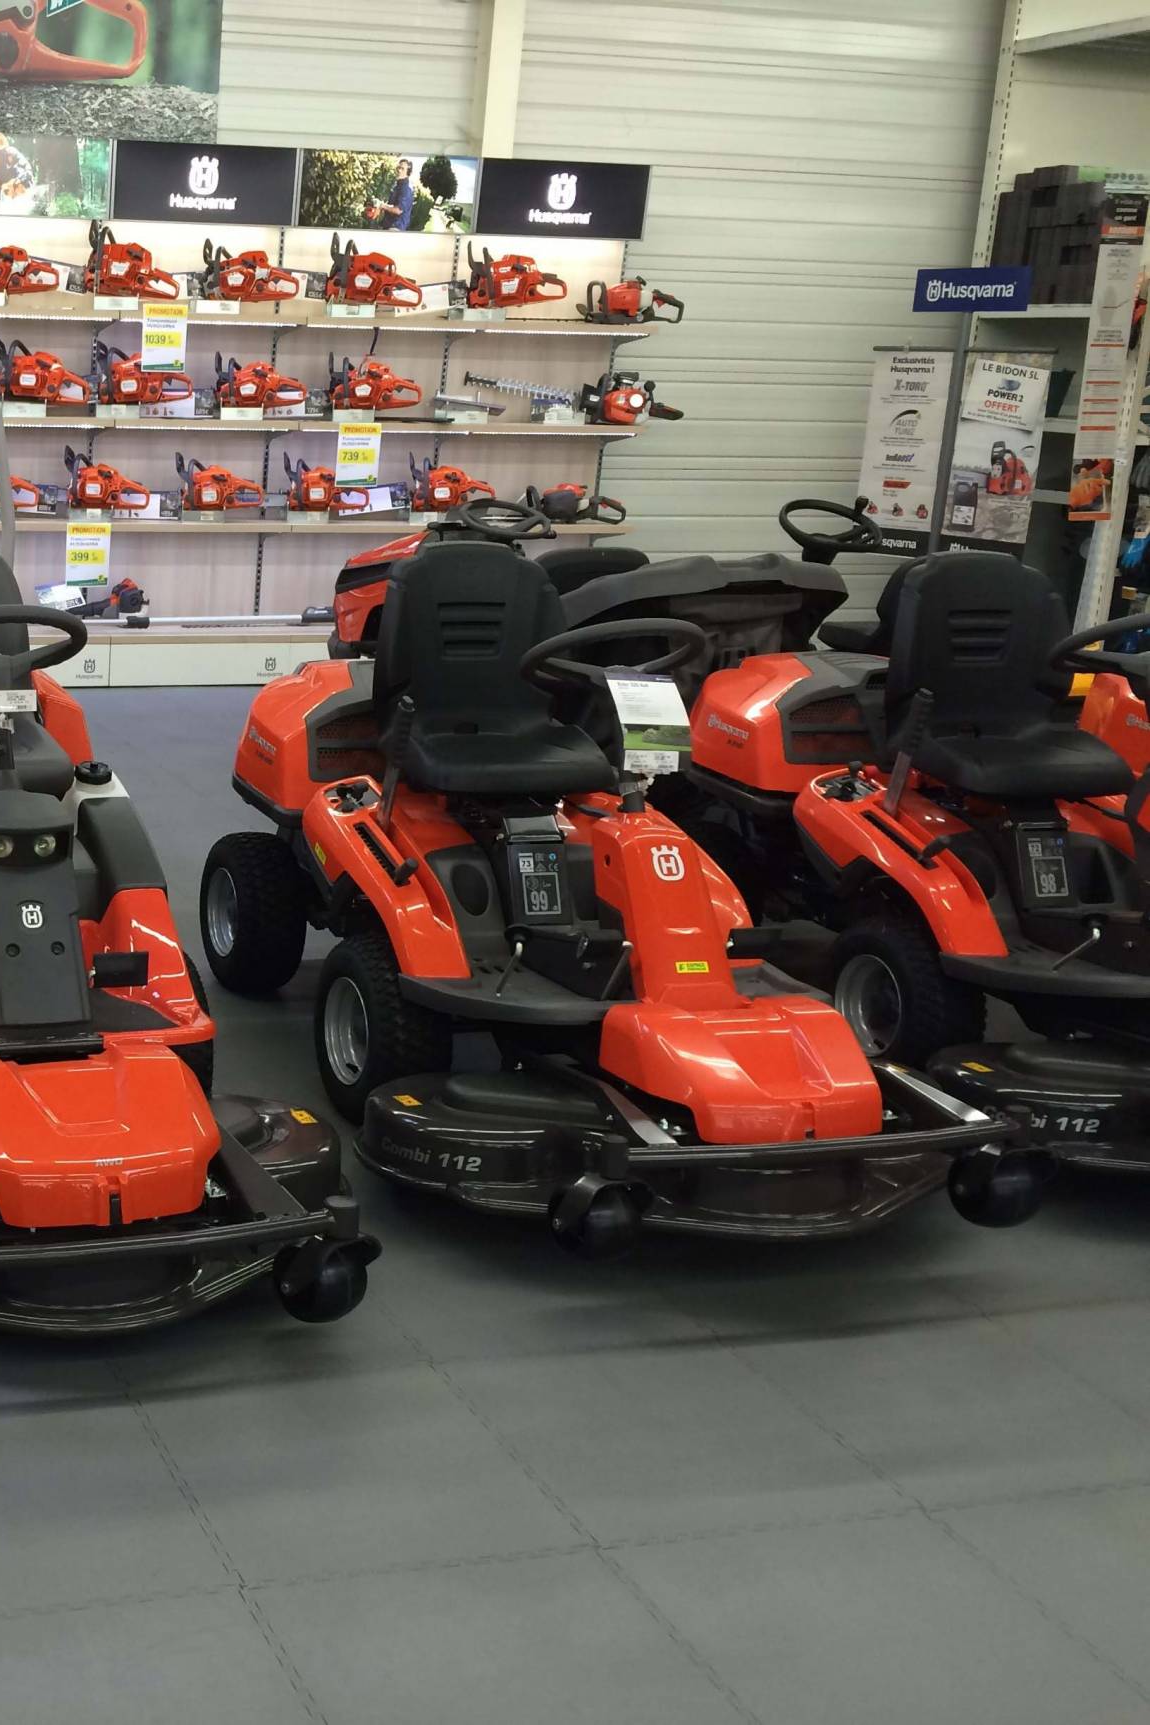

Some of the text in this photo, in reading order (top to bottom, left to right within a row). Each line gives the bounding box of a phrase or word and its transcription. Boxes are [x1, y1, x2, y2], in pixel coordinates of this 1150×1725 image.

[169, 192, 237, 211] Husqvarna
[528, 208, 592, 225] Husqvarna
[941, 281, 1015, 301] Husqvarna
[148, 307, 184, 316] PROMOTION
[145, 334, 167, 345] 1039
[890, 366, 930, 375] Husqvarna
[982, 362, 994, 372] LE
[995, 364, 1027, 378] BIDON
[987, 388, 1017, 402] POWER
[984, 399, 1021, 413] OFFERT
[342, 451, 359, 461] 739
[70, 551, 89, 562] 399
[530, 890, 549, 911] 99
[1055, 1116, 1101, 1133] 112
[381, 1137, 483, 1172] Combi 112
